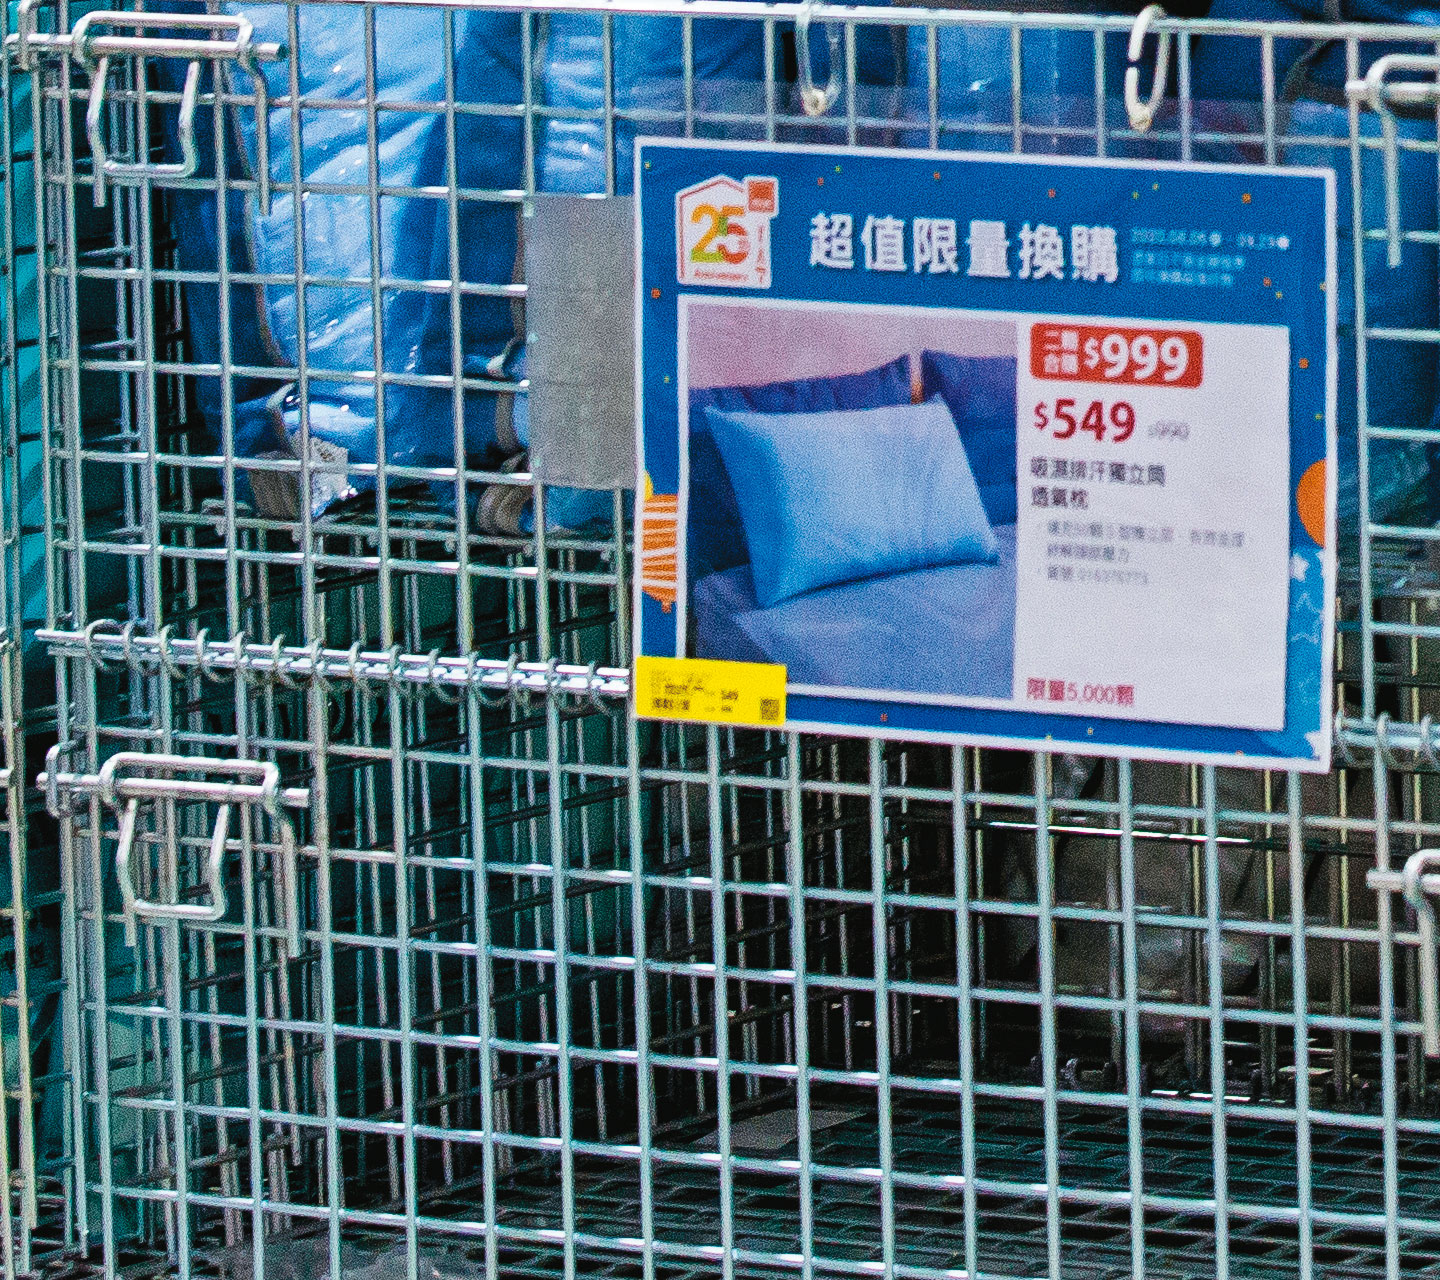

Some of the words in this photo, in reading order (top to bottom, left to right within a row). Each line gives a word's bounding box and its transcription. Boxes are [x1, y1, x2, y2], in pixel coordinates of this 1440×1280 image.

[690, 203, 752, 266] 25
[808, 211, 1121, 283] 超值限量換購
[1083, 332, 1190, 382] $999
[1033, 398, 1137, 444] $549
